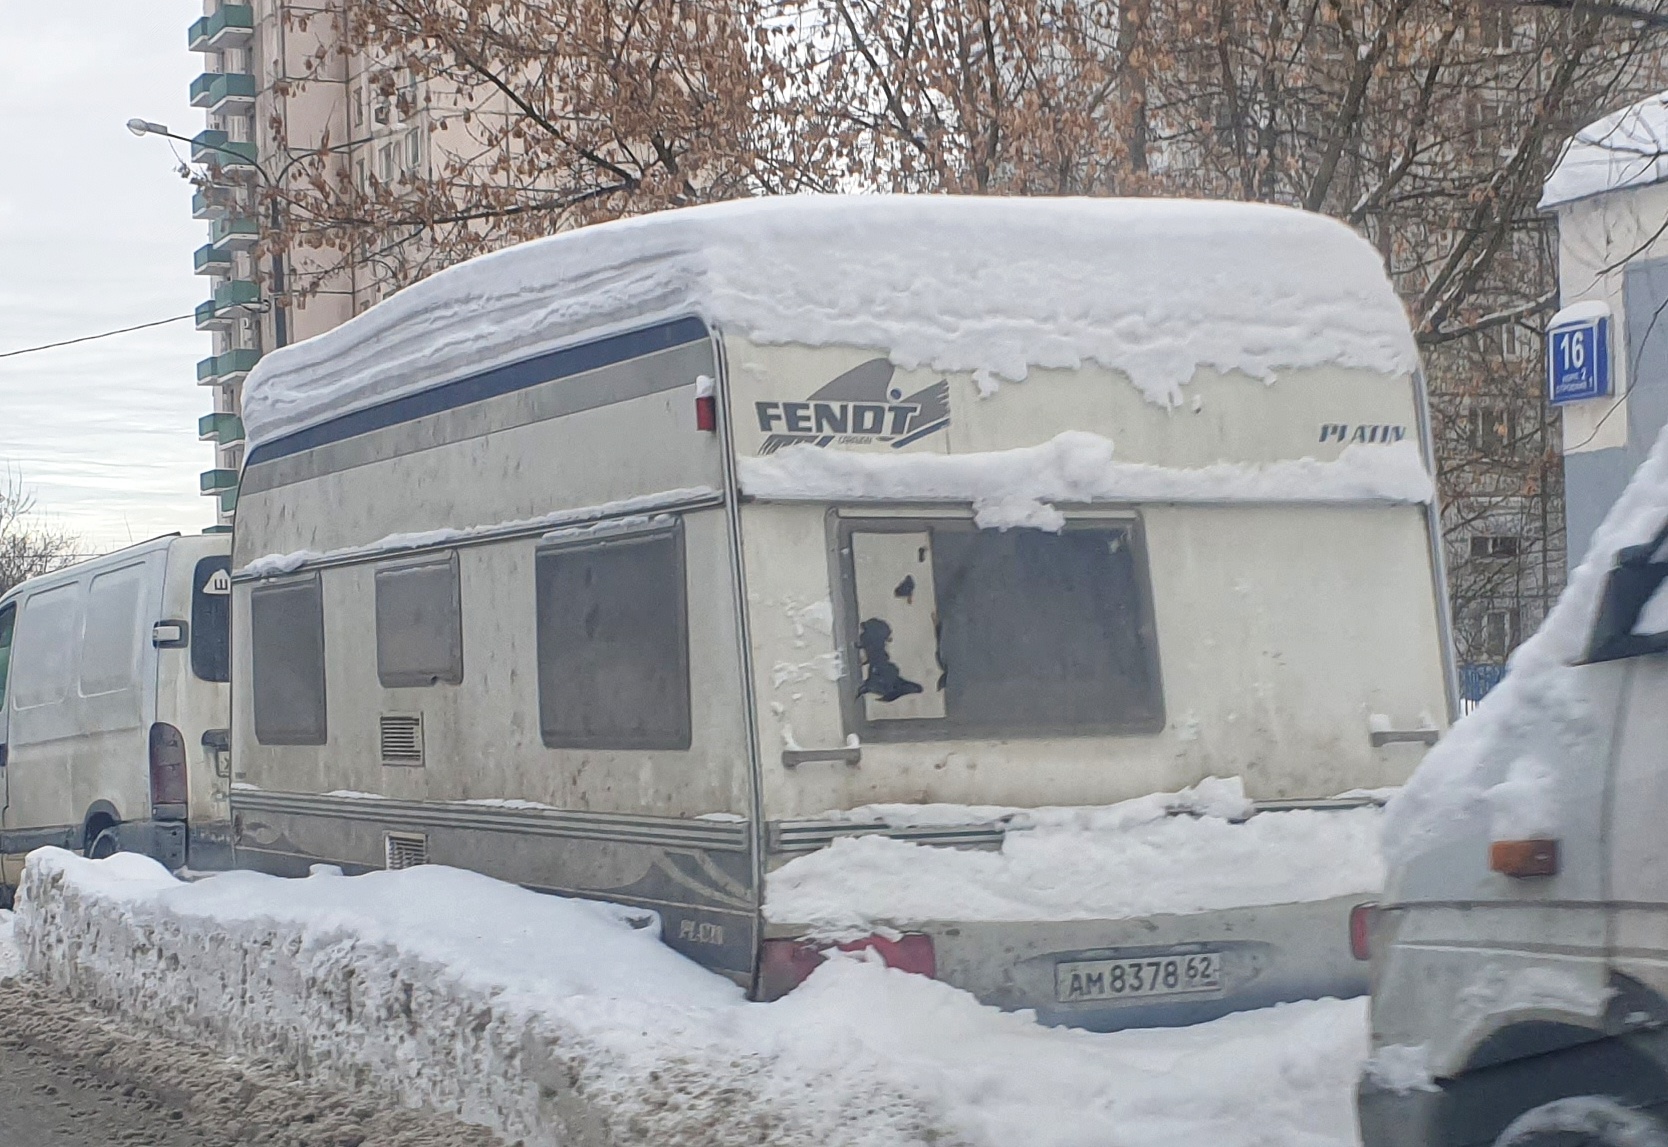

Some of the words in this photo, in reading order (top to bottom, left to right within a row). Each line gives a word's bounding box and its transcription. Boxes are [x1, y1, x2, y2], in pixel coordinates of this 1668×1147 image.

[1560, 331, 1584, 370] 16
[755, 402, 917, 434] FENDT
[1185, 956, 1212, 979] 62
